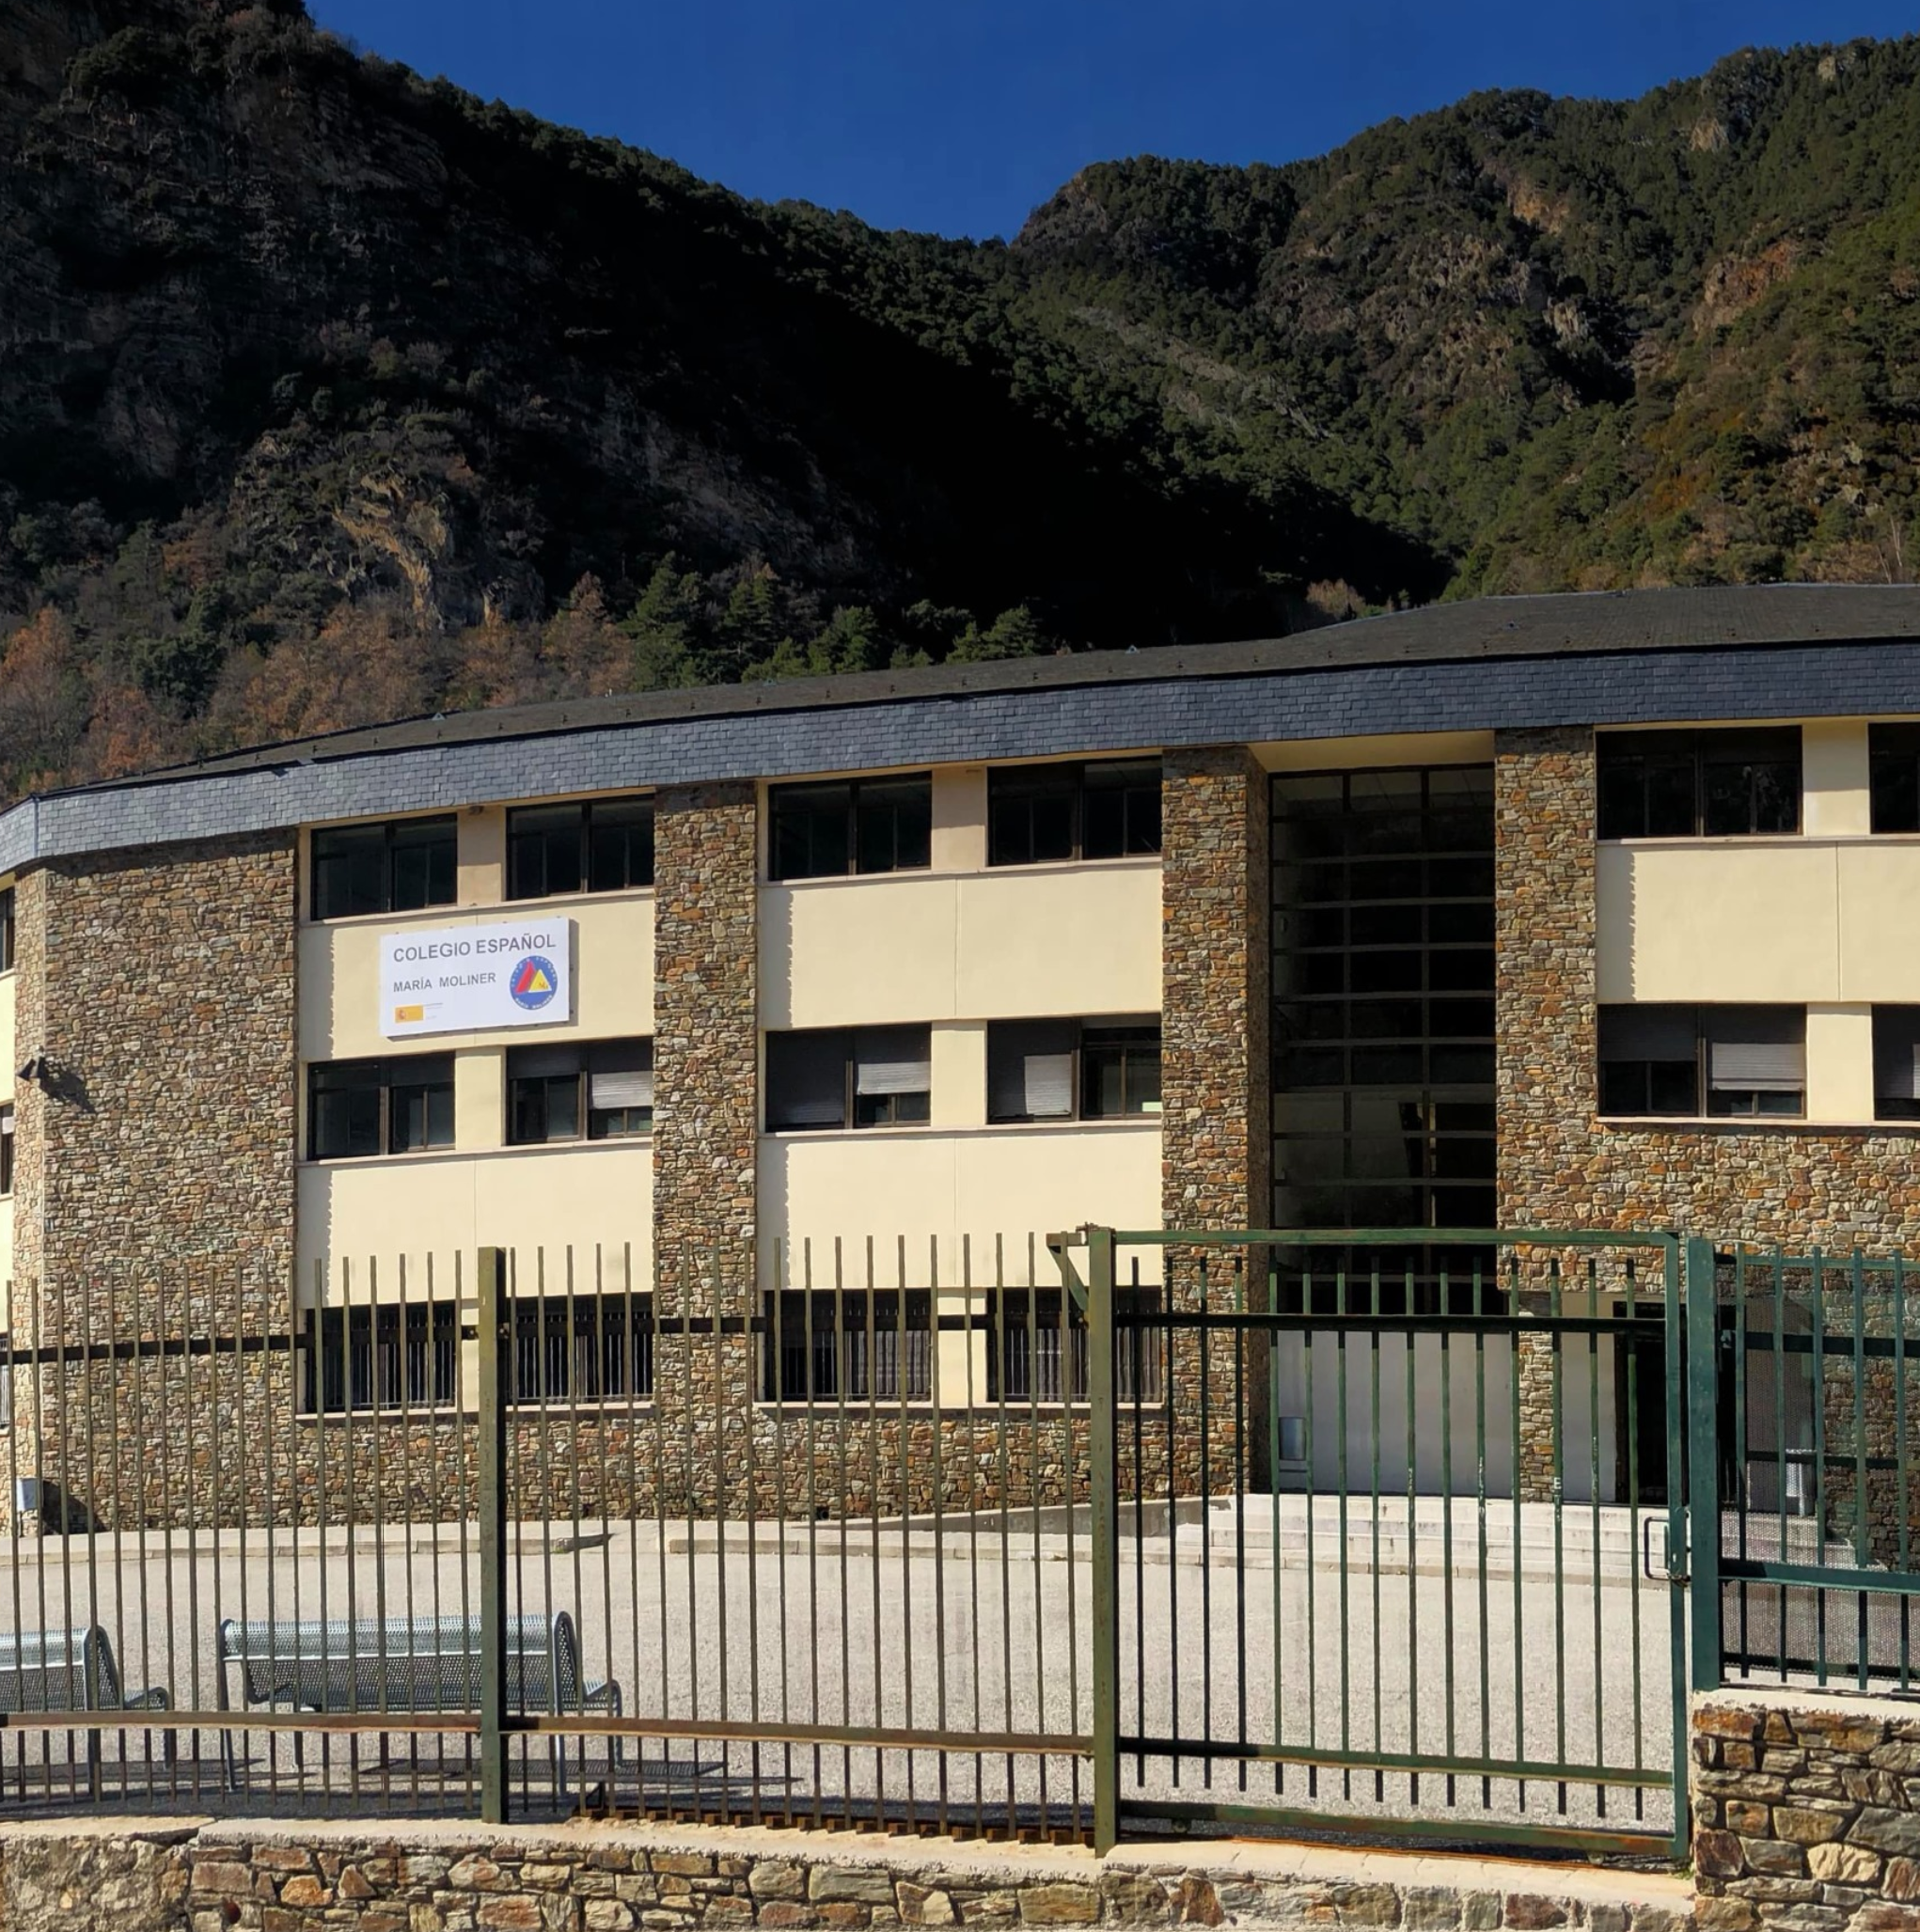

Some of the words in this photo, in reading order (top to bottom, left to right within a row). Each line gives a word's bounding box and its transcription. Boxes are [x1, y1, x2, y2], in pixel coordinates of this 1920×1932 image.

[393, 942, 471, 963] COLEGIO
[476, 933, 557, 953] ESPAÑOL
[393, 976, 433, 993] MARÍA
[439, 972, 496, 988] MOLINER
